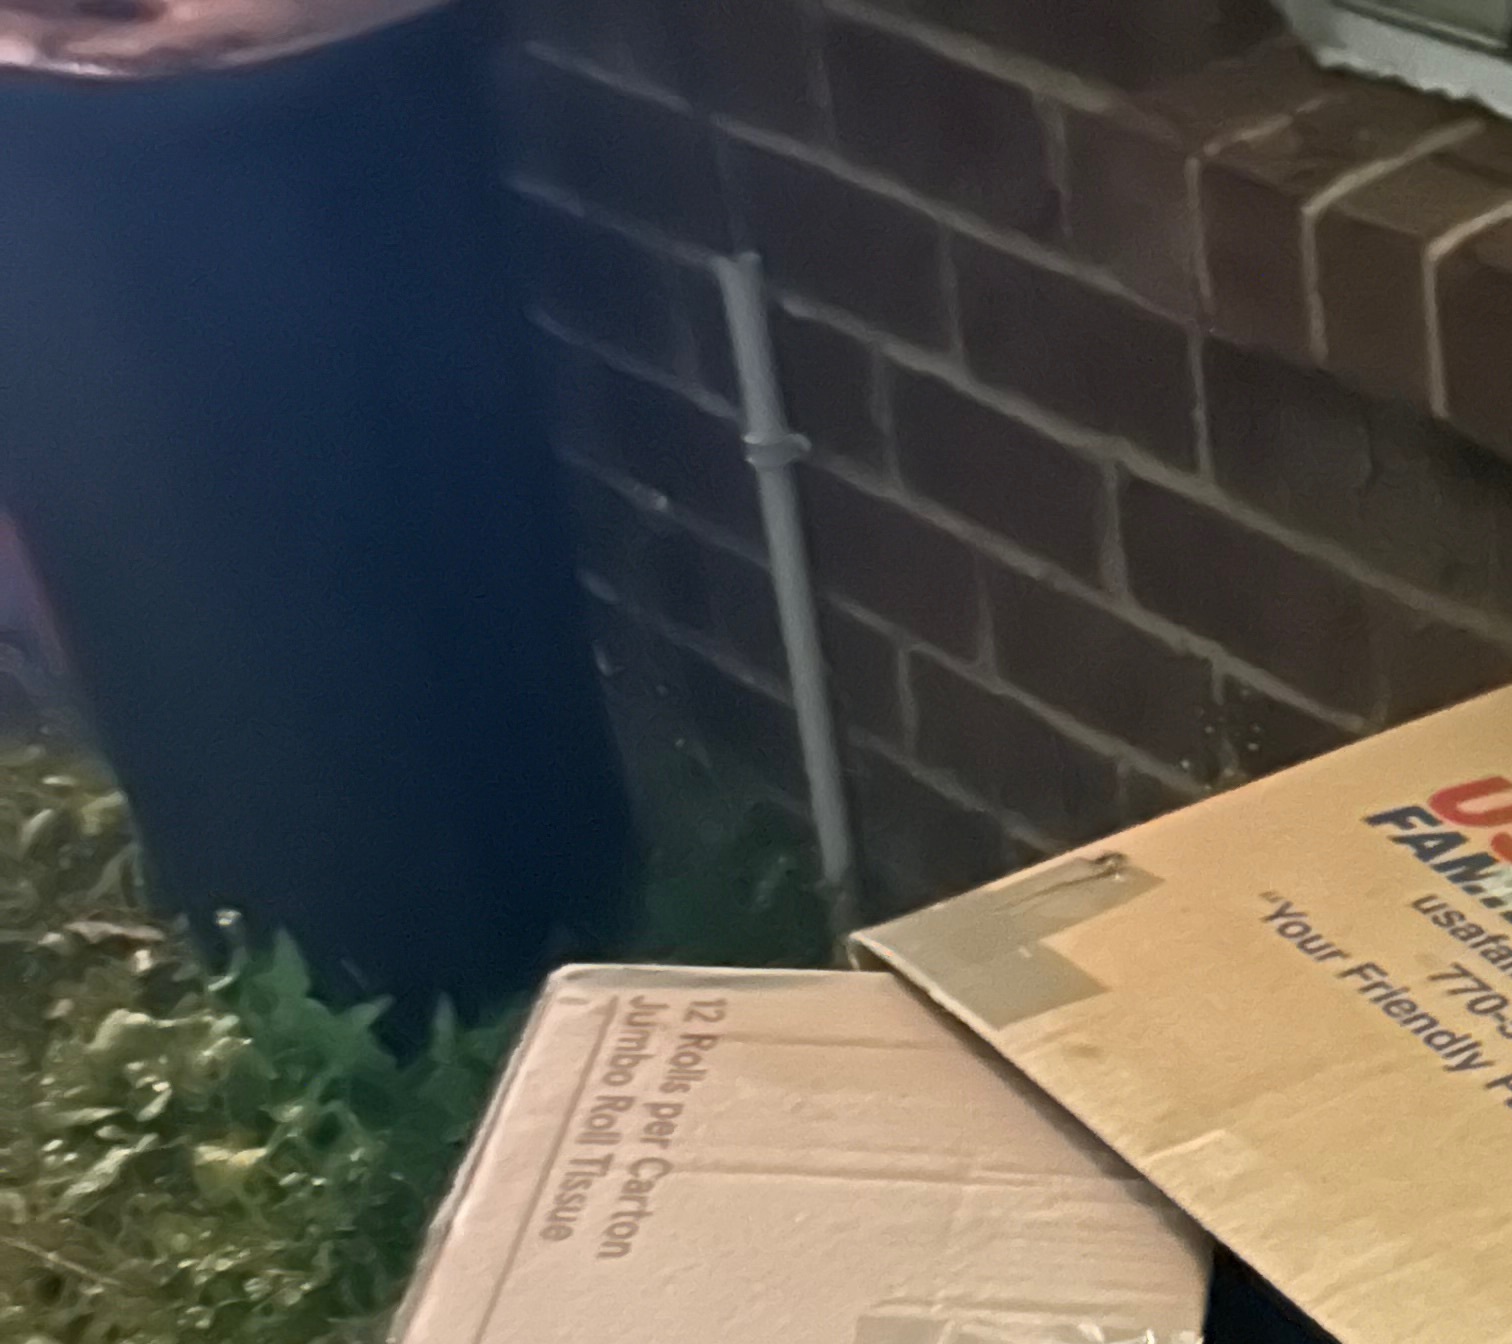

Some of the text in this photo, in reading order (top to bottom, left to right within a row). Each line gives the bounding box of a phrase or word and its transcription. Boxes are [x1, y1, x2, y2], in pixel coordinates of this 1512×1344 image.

[538, 995, 669, 1242] Jumbo Roll Tissue
[595, 999, 727, 1259] 12 Rolls per Carton
[1336, 962, 1495, 1072] Friendly
